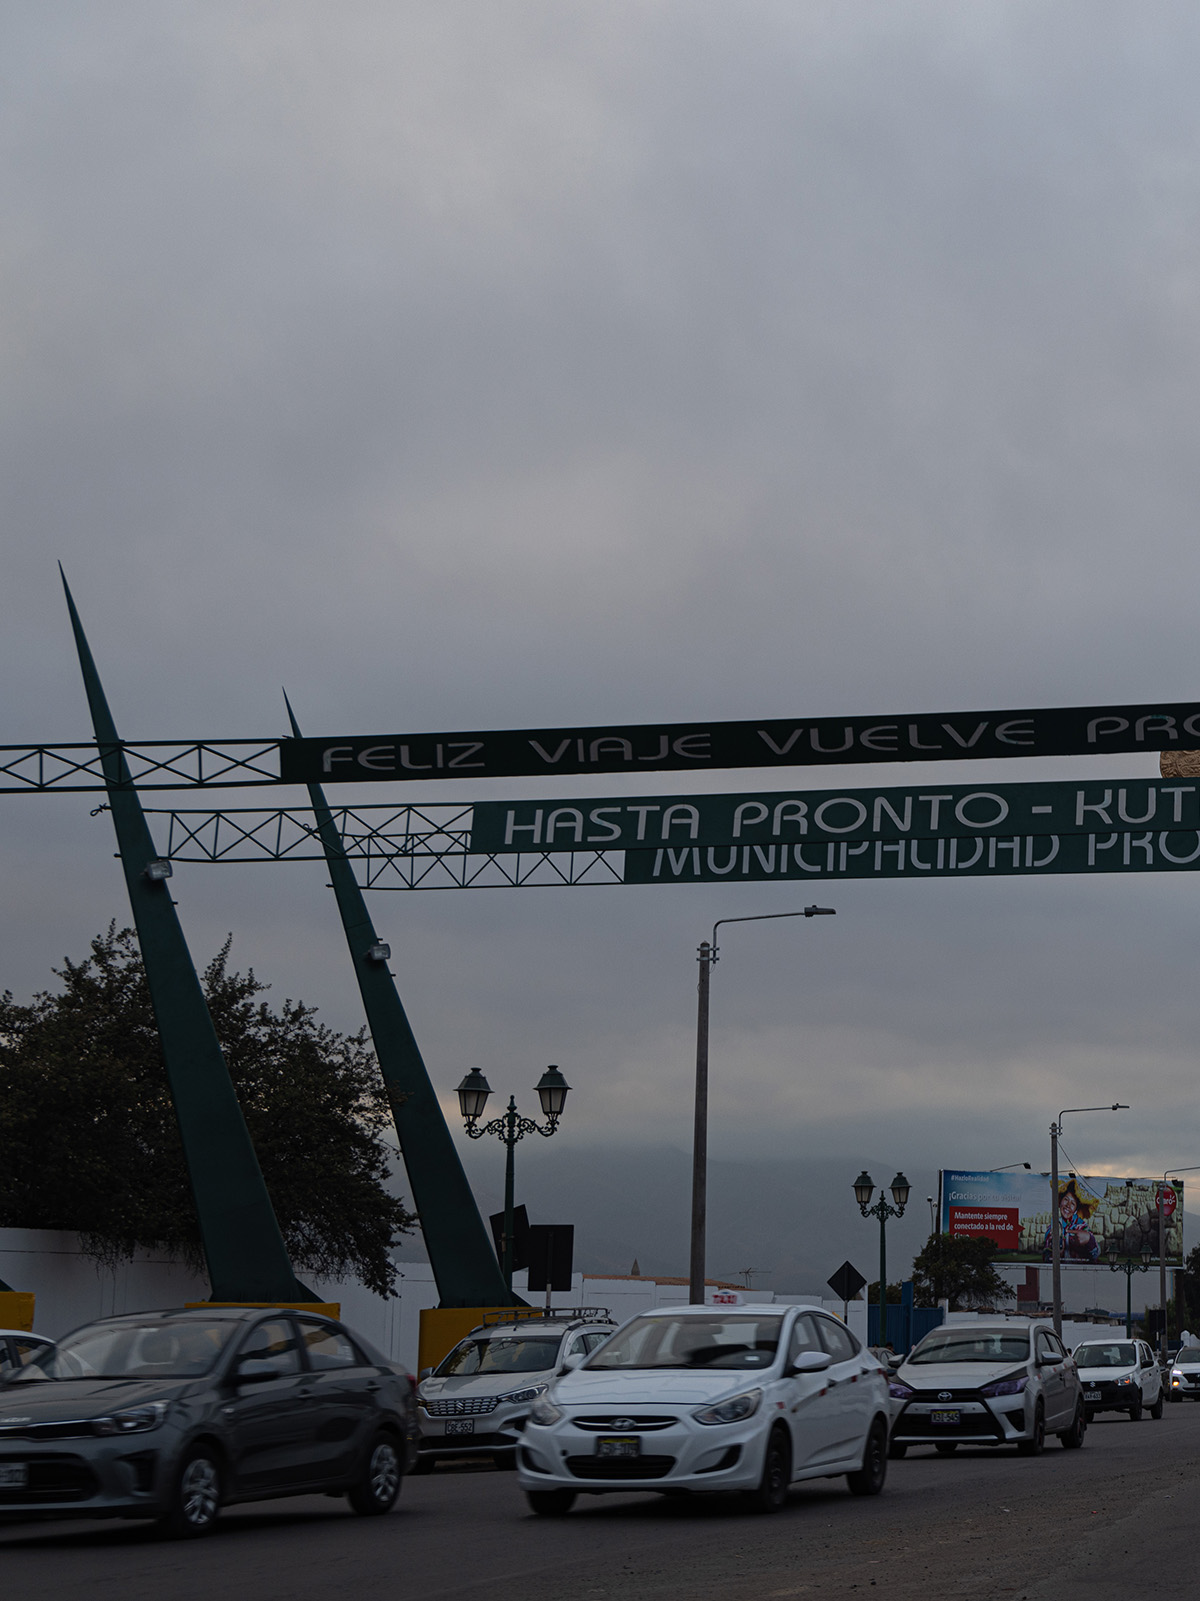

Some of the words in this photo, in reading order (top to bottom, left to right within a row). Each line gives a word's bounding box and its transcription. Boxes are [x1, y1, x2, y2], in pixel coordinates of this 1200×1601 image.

[323, 742, 485, 772] FELIZ
[528, 733, 711, 764] VIAJE
[757, 719, 1035, 755] VUELVE
[504, 803, 700, 845] HASTA
[732, 792, 1009, 838] PRONTO
[652, 834, 1060, 877] MUNICIPALIDAD
[984, 1213, 1008, 1221] siempre
